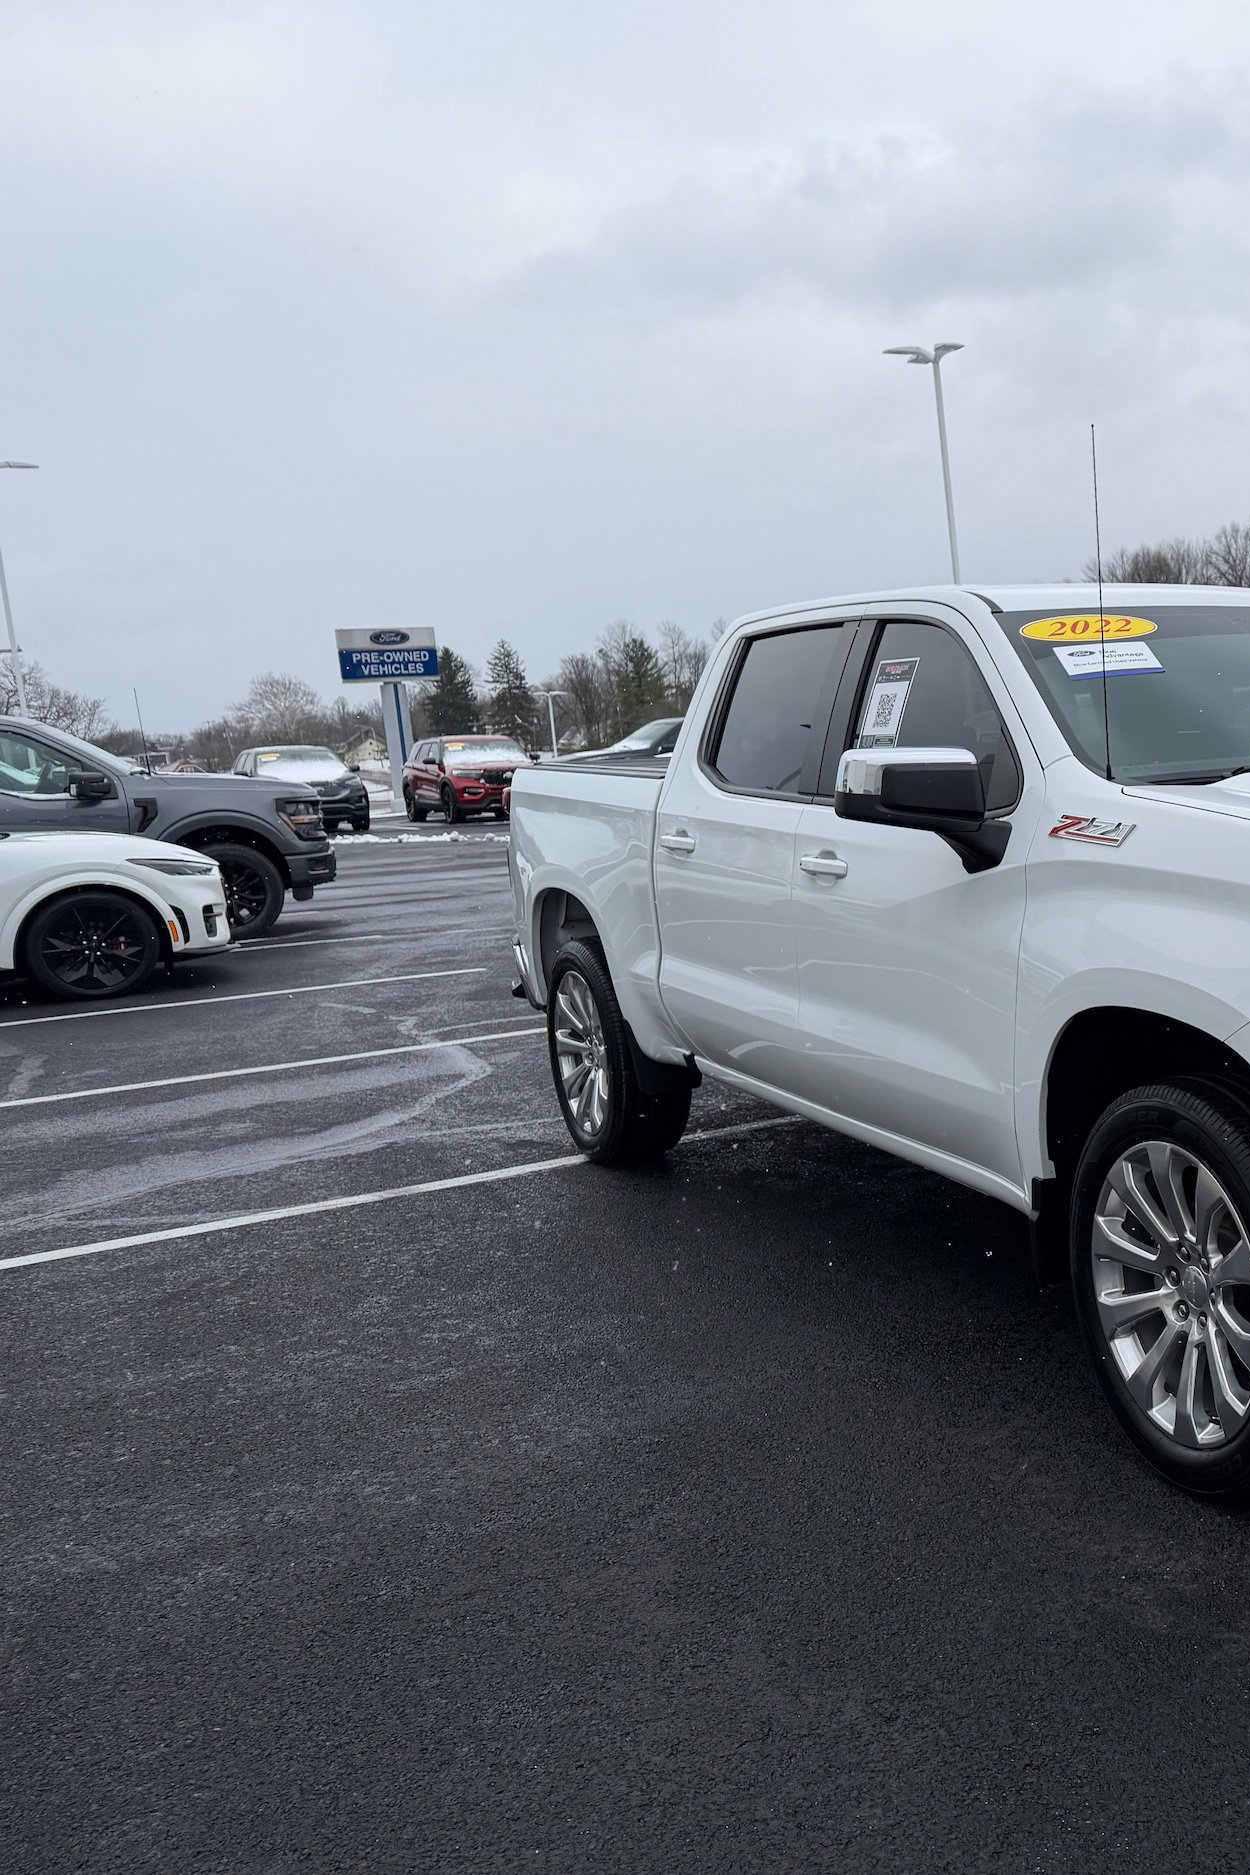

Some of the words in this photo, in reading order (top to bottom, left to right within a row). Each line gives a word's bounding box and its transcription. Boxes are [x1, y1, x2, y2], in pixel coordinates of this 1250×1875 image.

[1048, 618, 1132, 637] 2022
[379, 633, 402, 643] Ford
[352, 650, 430, 664] PRE-OWNED
[361, 662, 425, 676] VEHICLES
[1048, 812, 1137, 848] Z71
